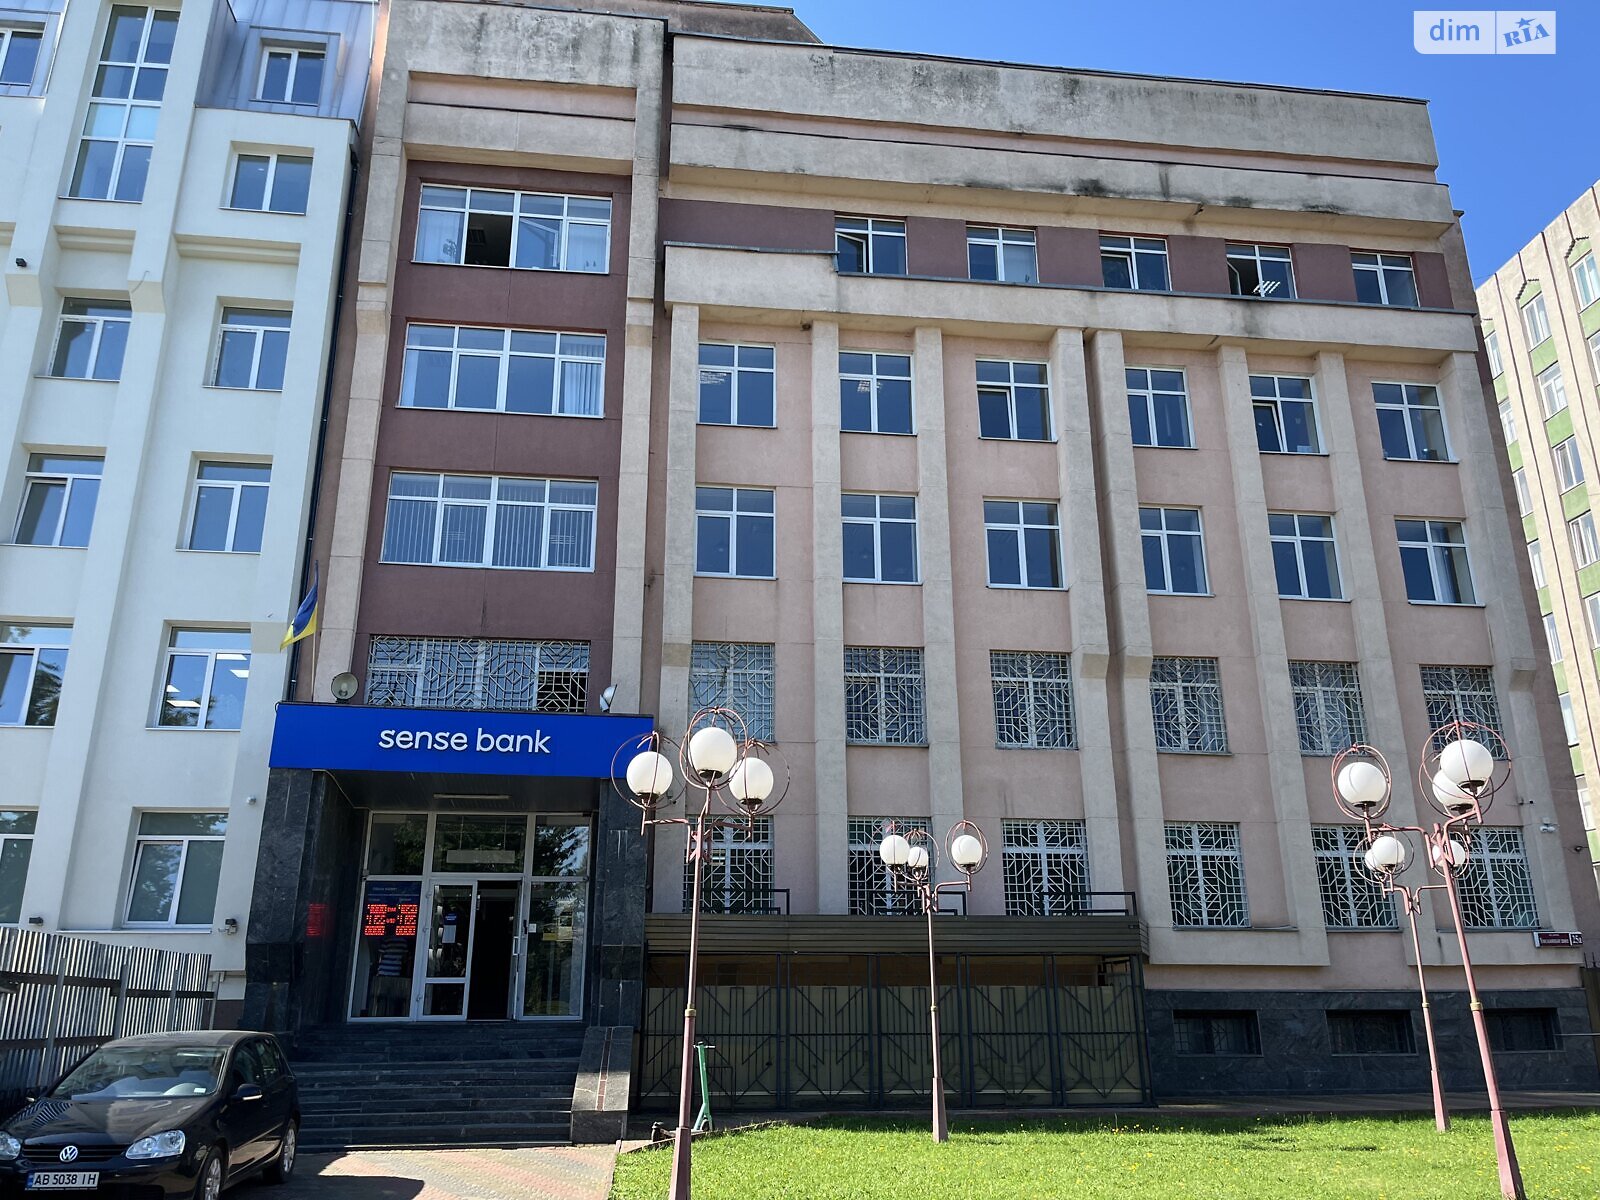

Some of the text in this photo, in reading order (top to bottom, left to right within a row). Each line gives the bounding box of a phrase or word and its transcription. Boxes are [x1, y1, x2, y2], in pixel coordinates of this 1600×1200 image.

[378, 727, 551, 754] sense bank
[34, 1174, 97, 1185] AB 5038 IH
